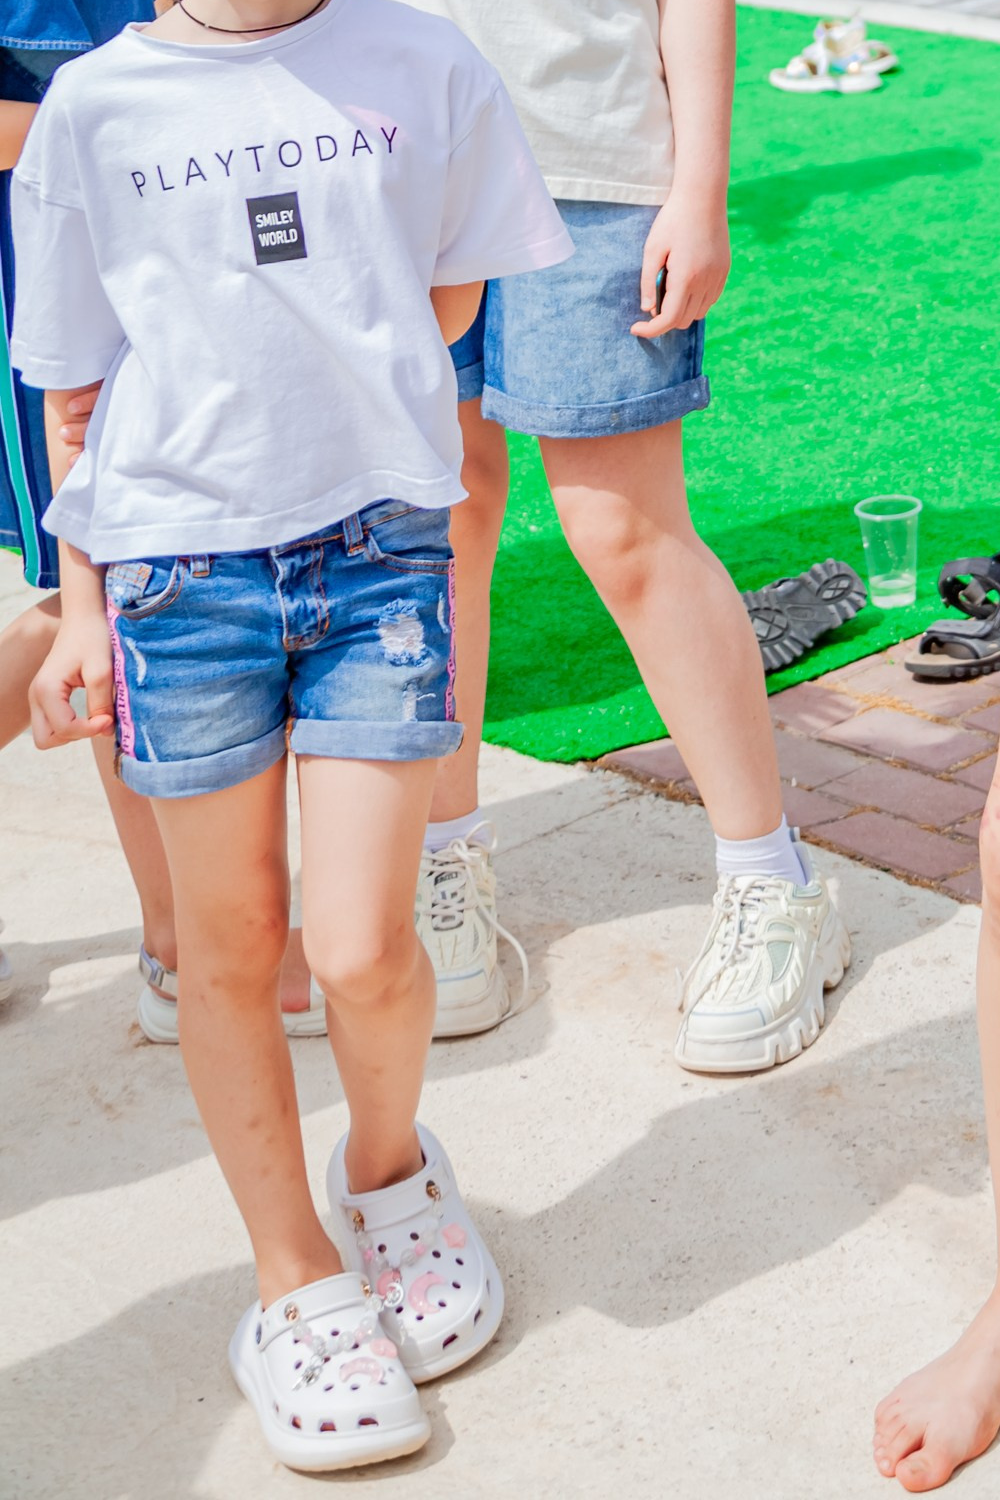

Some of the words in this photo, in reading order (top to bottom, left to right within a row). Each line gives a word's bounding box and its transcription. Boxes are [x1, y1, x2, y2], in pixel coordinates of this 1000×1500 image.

[131, 126, 398, 197] PLAYTODAY
[255, 209, 294, 228] SMILEY
[258, 228, 298, 247] WORLD
